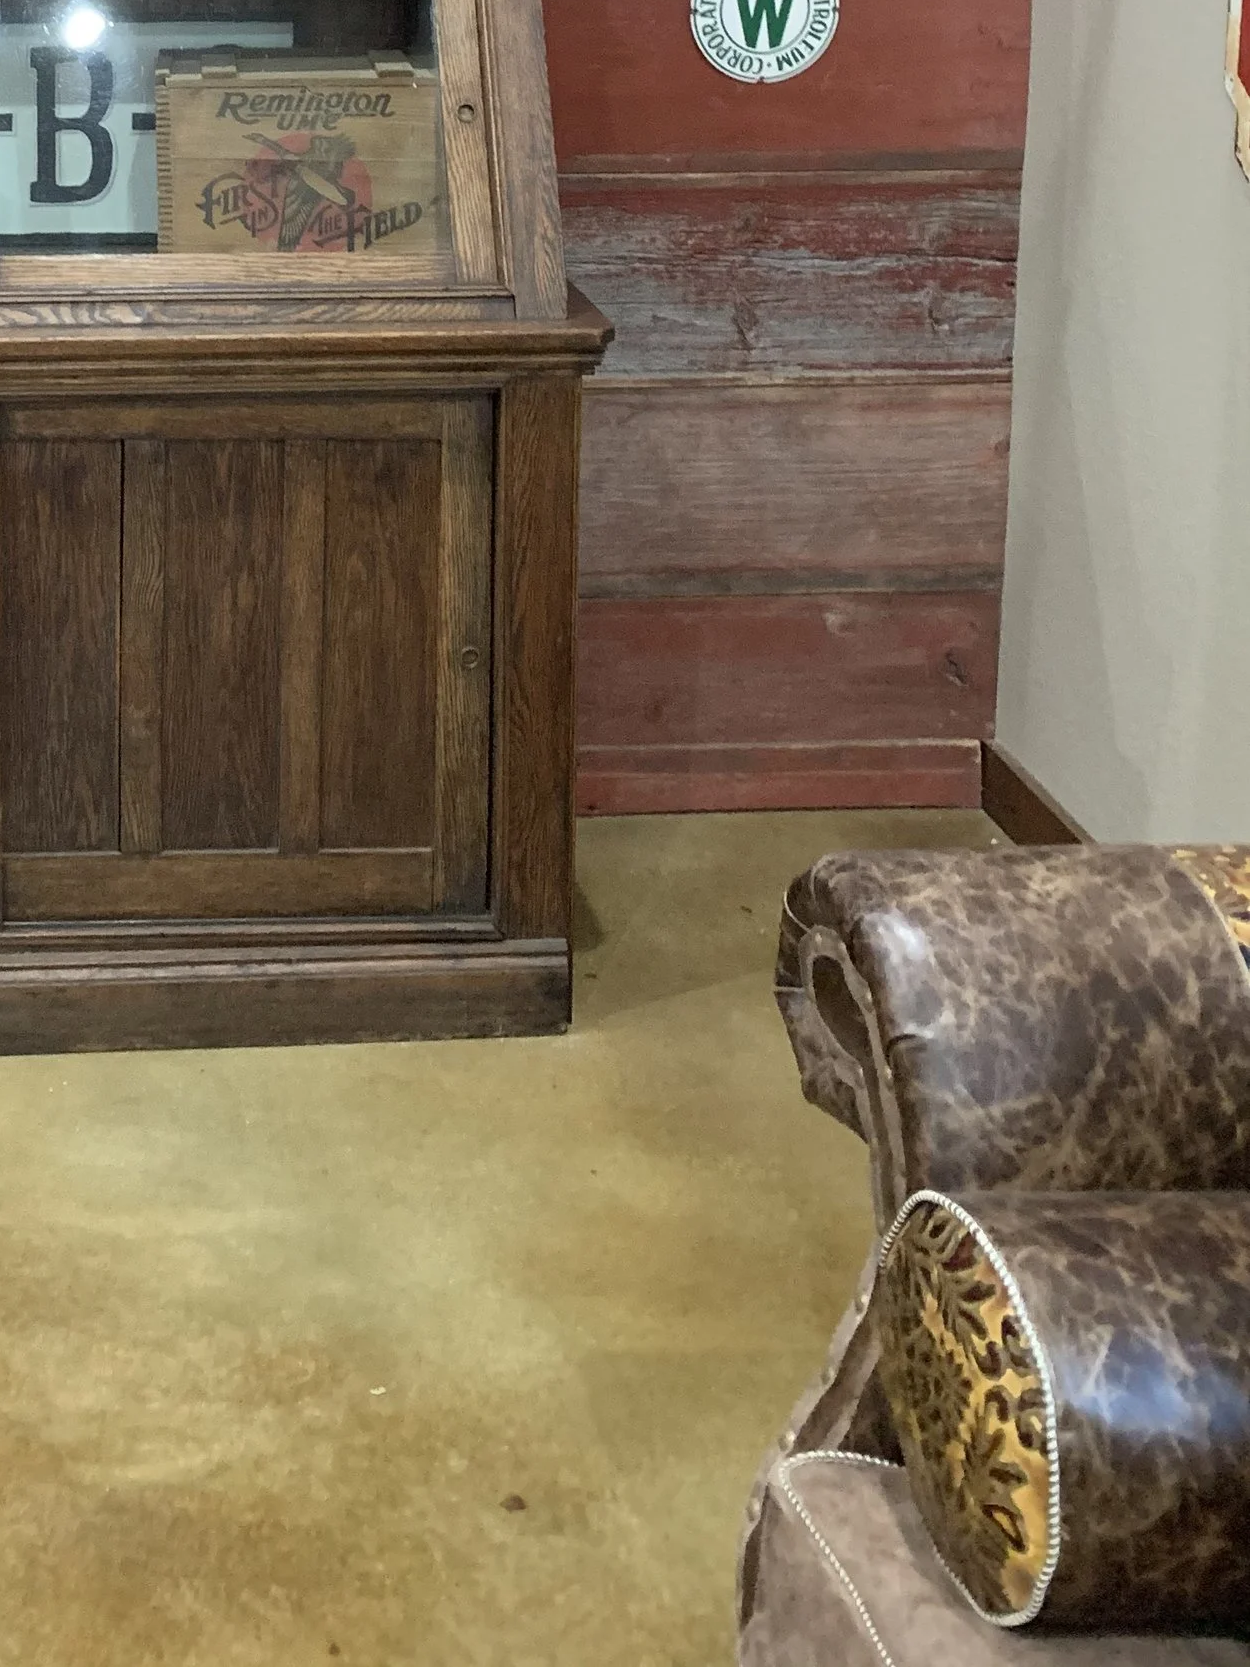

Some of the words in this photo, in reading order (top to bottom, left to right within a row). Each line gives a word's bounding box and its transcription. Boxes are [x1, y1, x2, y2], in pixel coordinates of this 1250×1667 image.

[216, 89, 396, 125] Remington
[276, 112, 342, 131] UMC
[346, 199, 424, 252] FIELD
